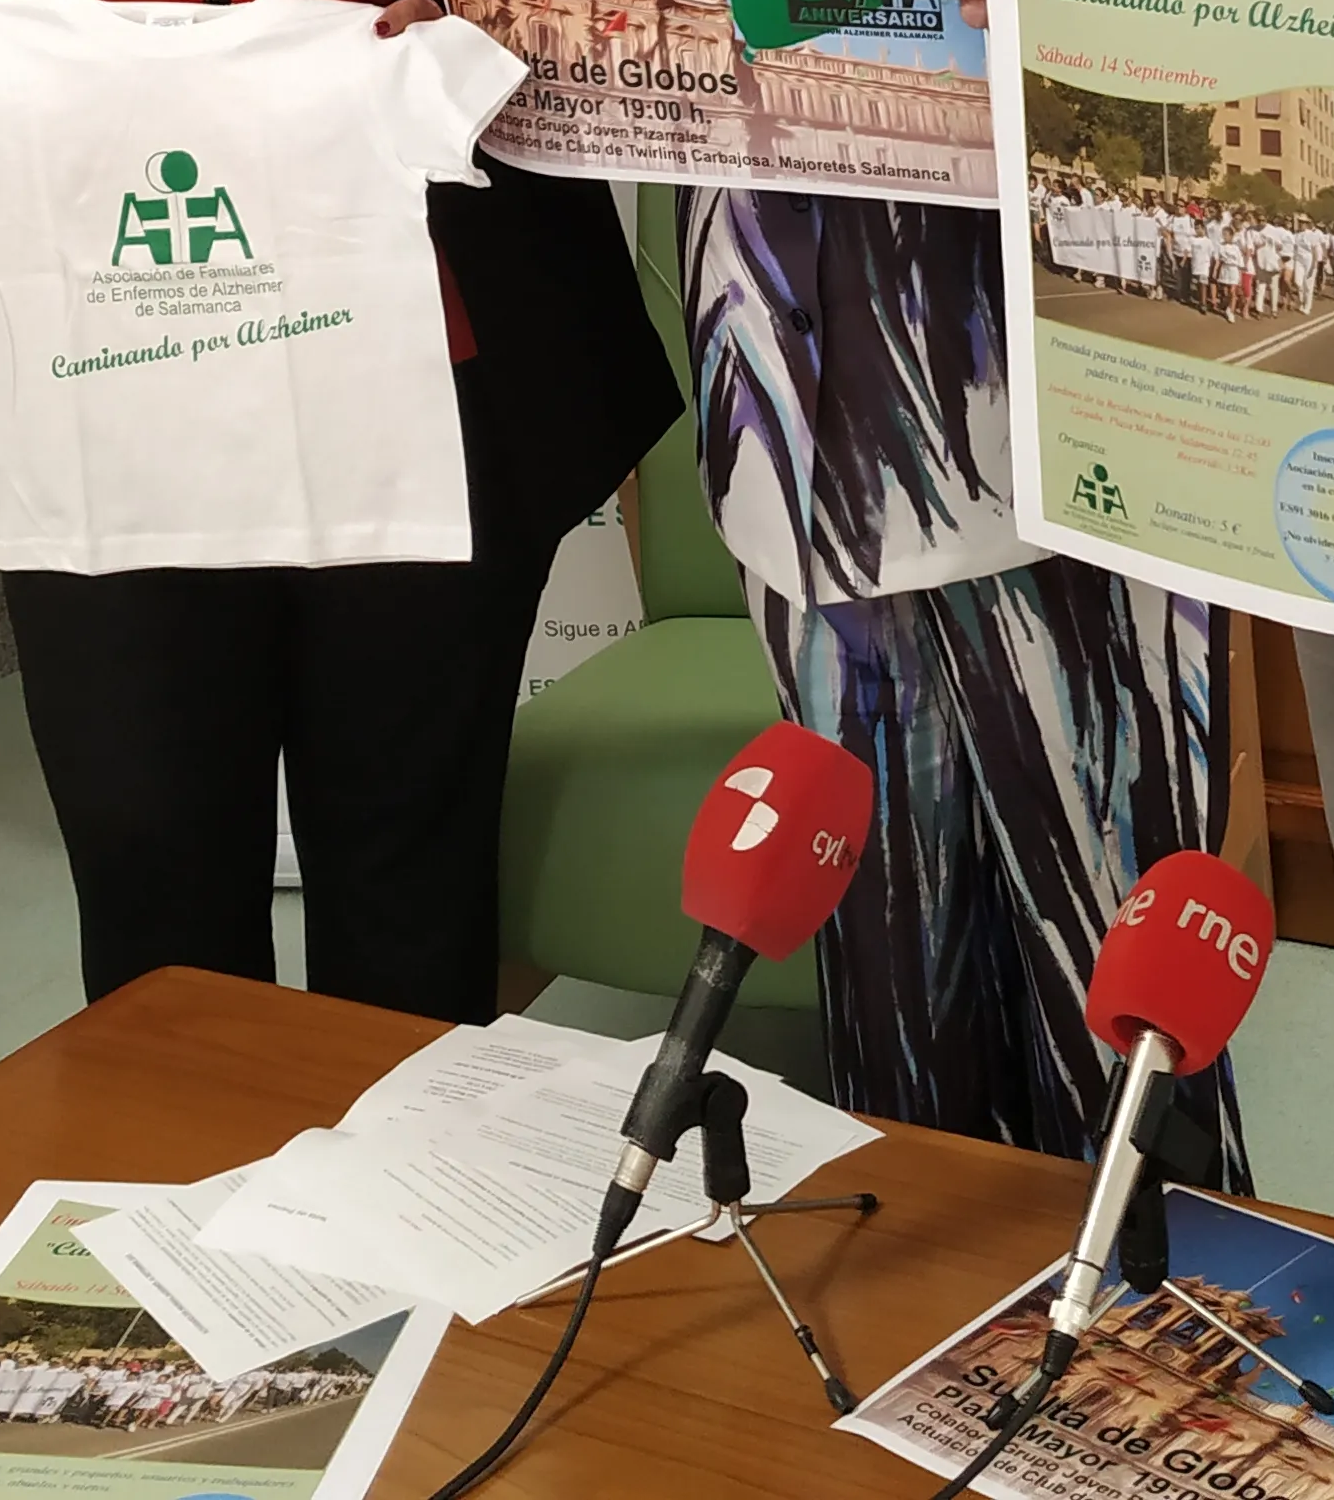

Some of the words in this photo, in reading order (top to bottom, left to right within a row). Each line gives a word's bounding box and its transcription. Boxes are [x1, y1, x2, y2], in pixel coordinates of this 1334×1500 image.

[798, 6, 938, 28] ANIVERSARIO
[1193, 2, 1240, 27] por
[570, 56, 607, 85] de
[619, 58, 738, 96] Globos
[1035, 44, 1094, 70] Sábado
[1100, 55, 1119, 73] 14
[1123, 59, 1218, 90] Septiembre
[534, 89, 604, 118] Mayor
[619, 97, 681, 122] 19:00
[690, 102, 712, 124] h.
[537, 117, 580, 136] Grupo
[583, 124, 629, 138] Joven
[633, 126, 708, 144] Pizarrales
[545, 135, 563, 151] de
[566, 139, 601, 154] Club
[605, 142, 623, 157] de
[628, 144, 687, 164] Twirling
[779, 156, 857, 175] Majoretes
[861, 162, 951, 182] Salamanca
[87, 289, 105, 303] de
[111, 285, 185, 302] Enfermos
[189, 284, 208, 298] de
[212, 279, 283, 297] Alzheimer
[92, 267, 172, 285] Asociación
[176, 268, 195, 280] de
[200, 261, 275, 279] Familiares
[135, 303, 154, 317] de
[158, 299, 242, 316] Salamanca
[52, 334, 185, 379] Caminando
[191, 334, 232, 361] por
[236, 307, 354, 348] Alzheimer
[1050, 336, 1091, 357] Pensada
[1092, 350, 1117, 364] para
[1154, 364, 1195, 384] grandes
[1085, 367, 1119, 384] padres
[1161, 387, 1202, 404] abuelos
[1302, 484, 1314, 492] en
[1317, 483, 1326, 494] la
[1155, 501, 1216, 529] Donativo:
[1219, 516, 1229, 532] 5
[1232, 522, 1242, 536] €
[544, 620, 600, 641] Sigue
[607, 623, 619, 637] a
[1177, 898, 1259, 980] rne
[962, 1364, 1091, 1431] Sulta
[1097, 1423, 1154, 1455] de
[1162, 1448, 1291, 1500] Glob
[1018, 1423, 1119, 1472] Mayor
[897, 1413, 980, 1459] Actuació
[994, 1459, 1018, 1474] de
[1021, 1470, 1068, 1496] Club
[1003, 1441, 1060, 1473] Grupo
[1062, 1468, 1122, 1499] Joven
